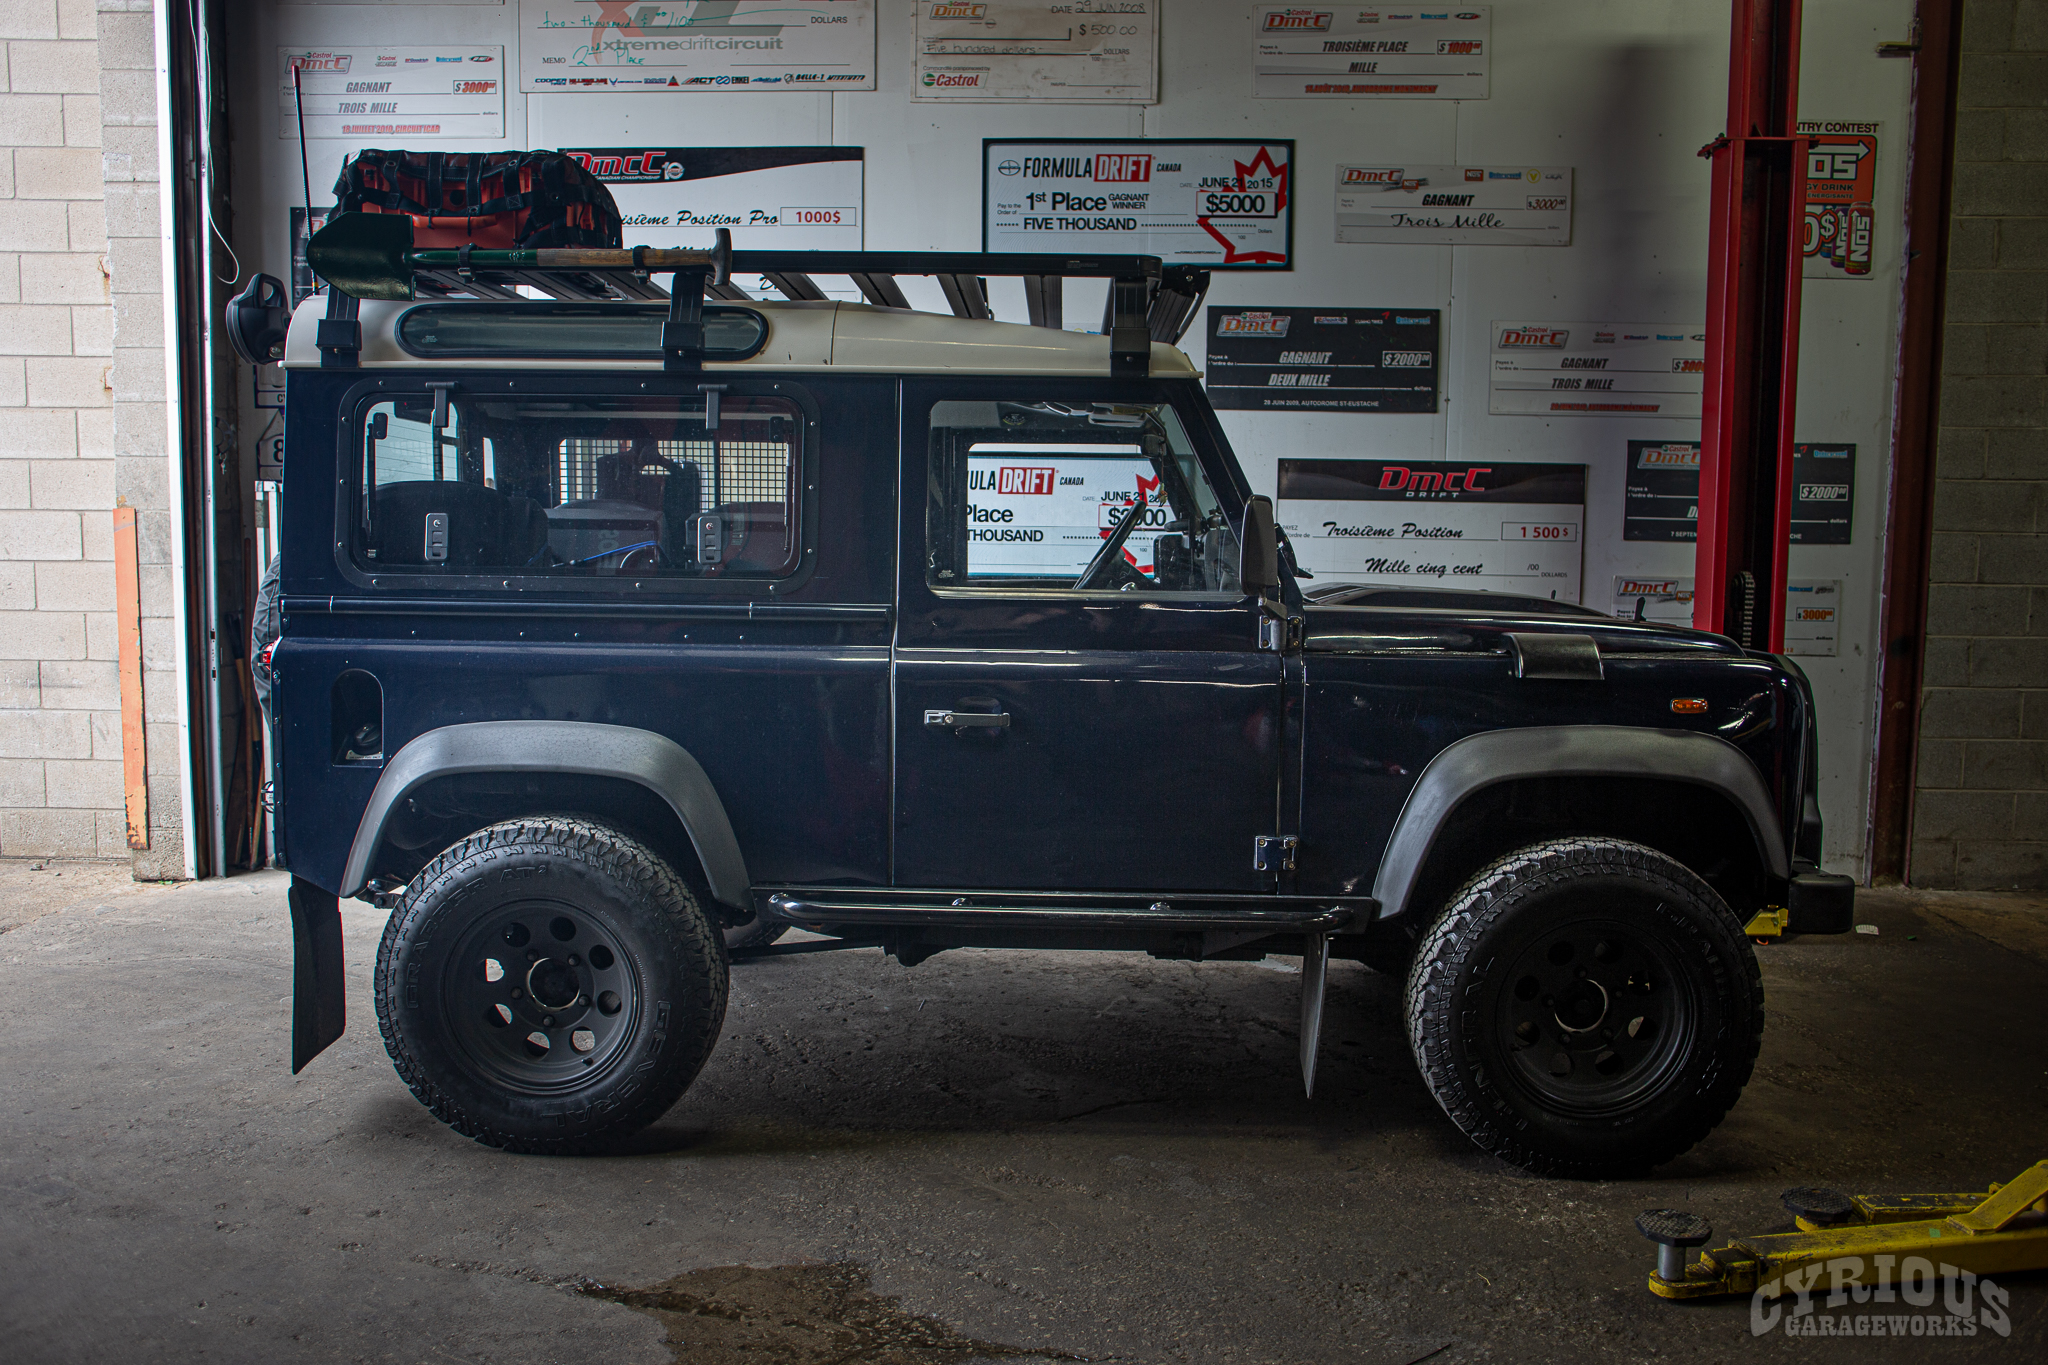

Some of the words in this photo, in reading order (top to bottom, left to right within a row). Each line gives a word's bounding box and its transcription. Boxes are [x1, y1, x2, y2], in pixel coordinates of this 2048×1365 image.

[1051, 5, 1073, 14] DATE
[1075, 1, 1092, 12] 29
[1119, 2, 1147, 12] 2008
[811, 16, 848, 24] DOLLARS
[1268, 15, 1327, 28] DmcC
[602, 38, 784, 50] xtremedriftcircuit
[926, 44, 947, 54] Five
[953, 43, 995, 54] hundred
[1322, 39, 1377, 52] TROISIÈME
[1378, 41, 1408, 52] PLACE
[1348, 62, 1379, 73] MILLE
[936, 74, 979, 87] Castrol
[346, 82, 392, 93] GAGNANT
[338, 103, 367, 114] TROIS
[370, 103, 398, 114] MILLE
[342, 125, 350, 133] 18
[351, 125, 376, 134] JUILLET
[395, 125, 423, 134] CIRCUIT
[424, 125, 441, 134] ICAR
[1825, 123, 1879, 133] CONTEST
[1023, 157, 1093, 178] FORMULA
[1096, 155, 1150, 181] DRIFT
[1156, 163, 1182, 172] CANADA
[1808, 154, 1858, 180] OS
[1346, 169, 1401, 182] DmcC
[1198, 178, 1230, 188] JUNE
[1232, 177, 1244, 188] 21
[1247, 180, 1259, 189] 20
[1260, 177, 1273, 188] 15
[1821, 183, 1855, 191] DRINK
[1025, 192, 1047, 211] 1st
[1052, 192, 1107, 211] Place
[1108, 193, 1150, 202] GAGNANT
[1206, 193, 1265, 214] $5000
[1422, 194, 1475, 207] GAGNANT
[1112, 202, 1146, 210] WINNER
[676, 210, 743, 226] Position
[749, 209, 779, 226] Pro
[795, 210, 842, 225] 1000$
[1391, 213, 1444, 228] Trois
[1450, 213, 1504, 228] Mille
[1023, 218, 1054, 230] FIVE
[1056, 218, 1137, 231] THOUSAND
[1224, 318, 1285, 332] DmcC
[1504, 331, 1565, 345] DmcC
[1279, 351, 1332, 364] GAGNANT
[1561, 358, 1609, 369] GAGNANT
[1681, 360, 1705, 372] 300
[1268, 374, 1298, 386] DEUX
[1300, 374, 1331, 386] MILLE
[1552, 378, 1582, 390] TROIS
[1584, 379, 1614, 390] MILLE
[1001, 468, 1053, 494] DRIFT
[1059, 476, 1085, 486] CANADA
[1378, 466, 1492, 492] DmcC
[1100, 491, 1132, 502] JUNE
[1133, 491, 1146, 502] 21
[967, 529, 1044, 542] THOUSAND
[1322, 521, 1395, 538] Troisième
[1401, 522, 1463, 539] Position
[1364, 557, 1411, 574] Mille
[1453, 562, 1483, 576] cent
[1622, 581, 1677, 593] DmcC
[542, 1000, 672, 1129] GENERAL
